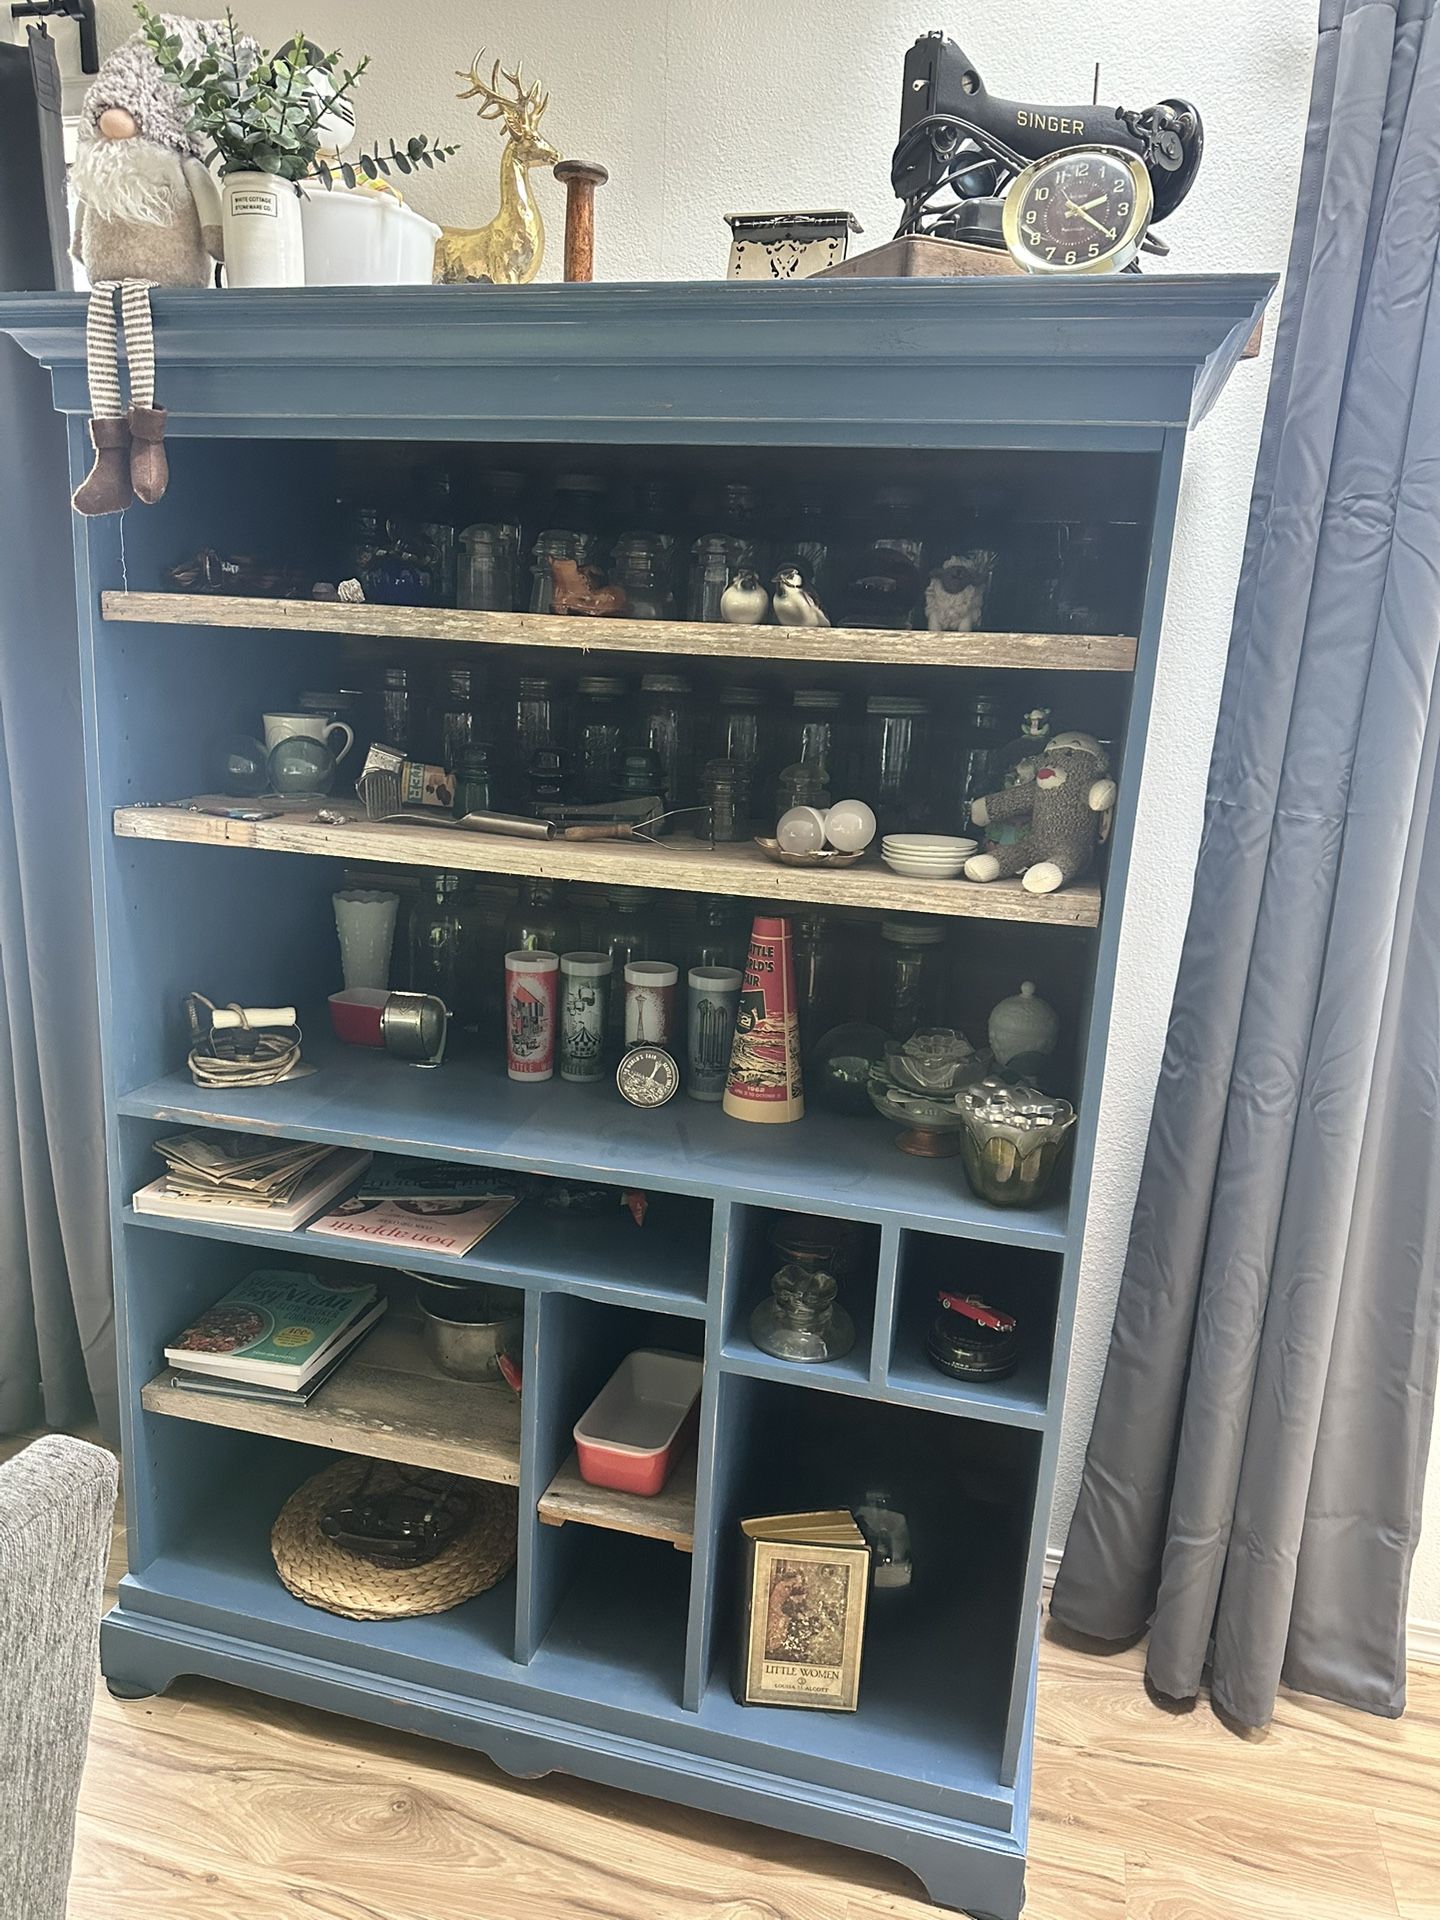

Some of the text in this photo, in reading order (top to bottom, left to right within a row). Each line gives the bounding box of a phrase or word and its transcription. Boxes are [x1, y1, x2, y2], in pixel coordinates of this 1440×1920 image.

[1017, 110, 1085, 136] SINGER
[1075, 164, 1089, 177] 12
[1099, 167, 1106, 179] 1
[1056, 171, 1066, 184] 11
[1113, 179, 1125, 193] 2
[248, 196, 272, 204] COTTAGE
[1035, 187, 1050, 201] 10
[1117, 203, 1129, 216] 3
[1026, 210, 1037, 224] 9
[1030, 232, 1041, 245] 8
[1107, 227, 1117, 240] 4
[1045, 247, 1057, 260] 7
[1088, 244, 1099, 257] 5
[1065, 251, 1077, 265] 6
[511, 1062, 534, 1073] ATTLE
[411, 1232, 457, 1248] bon
[765, 1664, 840, 1680] LITTLE WOMEN
